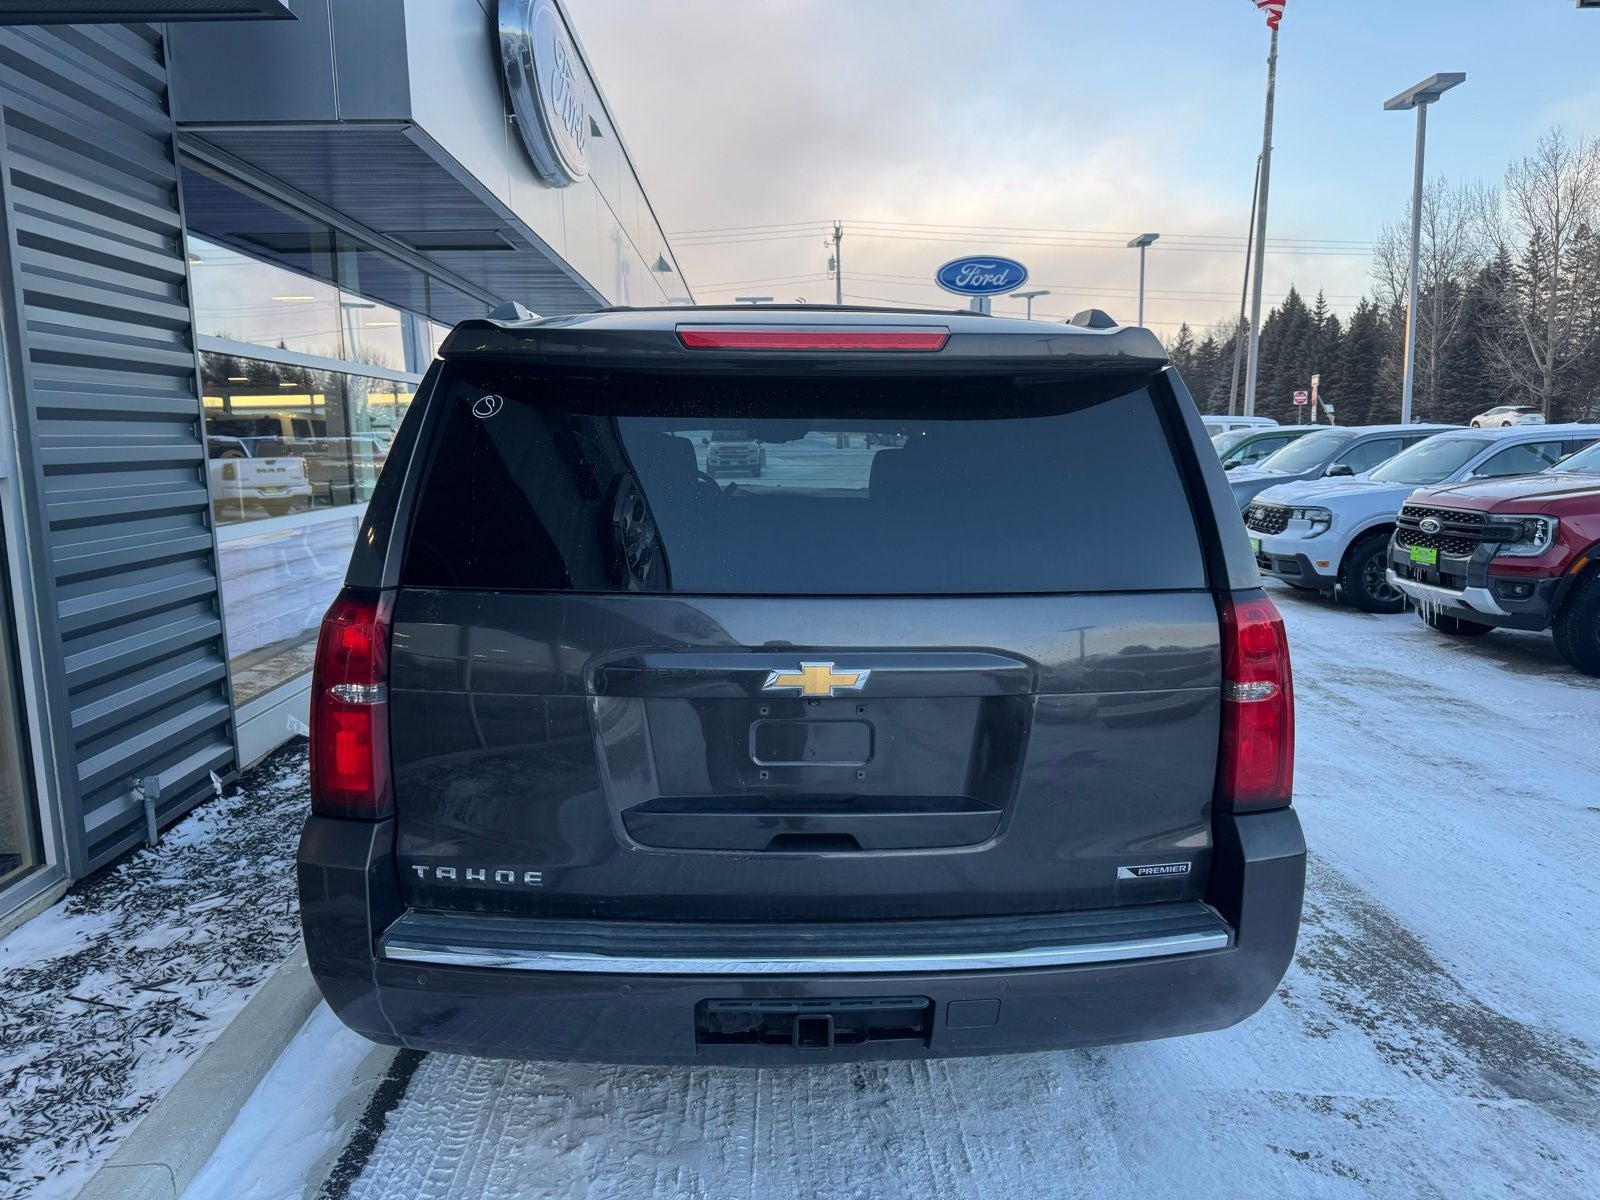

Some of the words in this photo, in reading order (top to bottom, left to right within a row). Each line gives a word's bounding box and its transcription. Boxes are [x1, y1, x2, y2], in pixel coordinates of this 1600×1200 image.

[552, 35, 586, 154] Ford
[955, 263, 1010, 287] Ford
[411, 865, 543, 886] TAHOE
[1138, 865, 1187, 875] PREMIER
